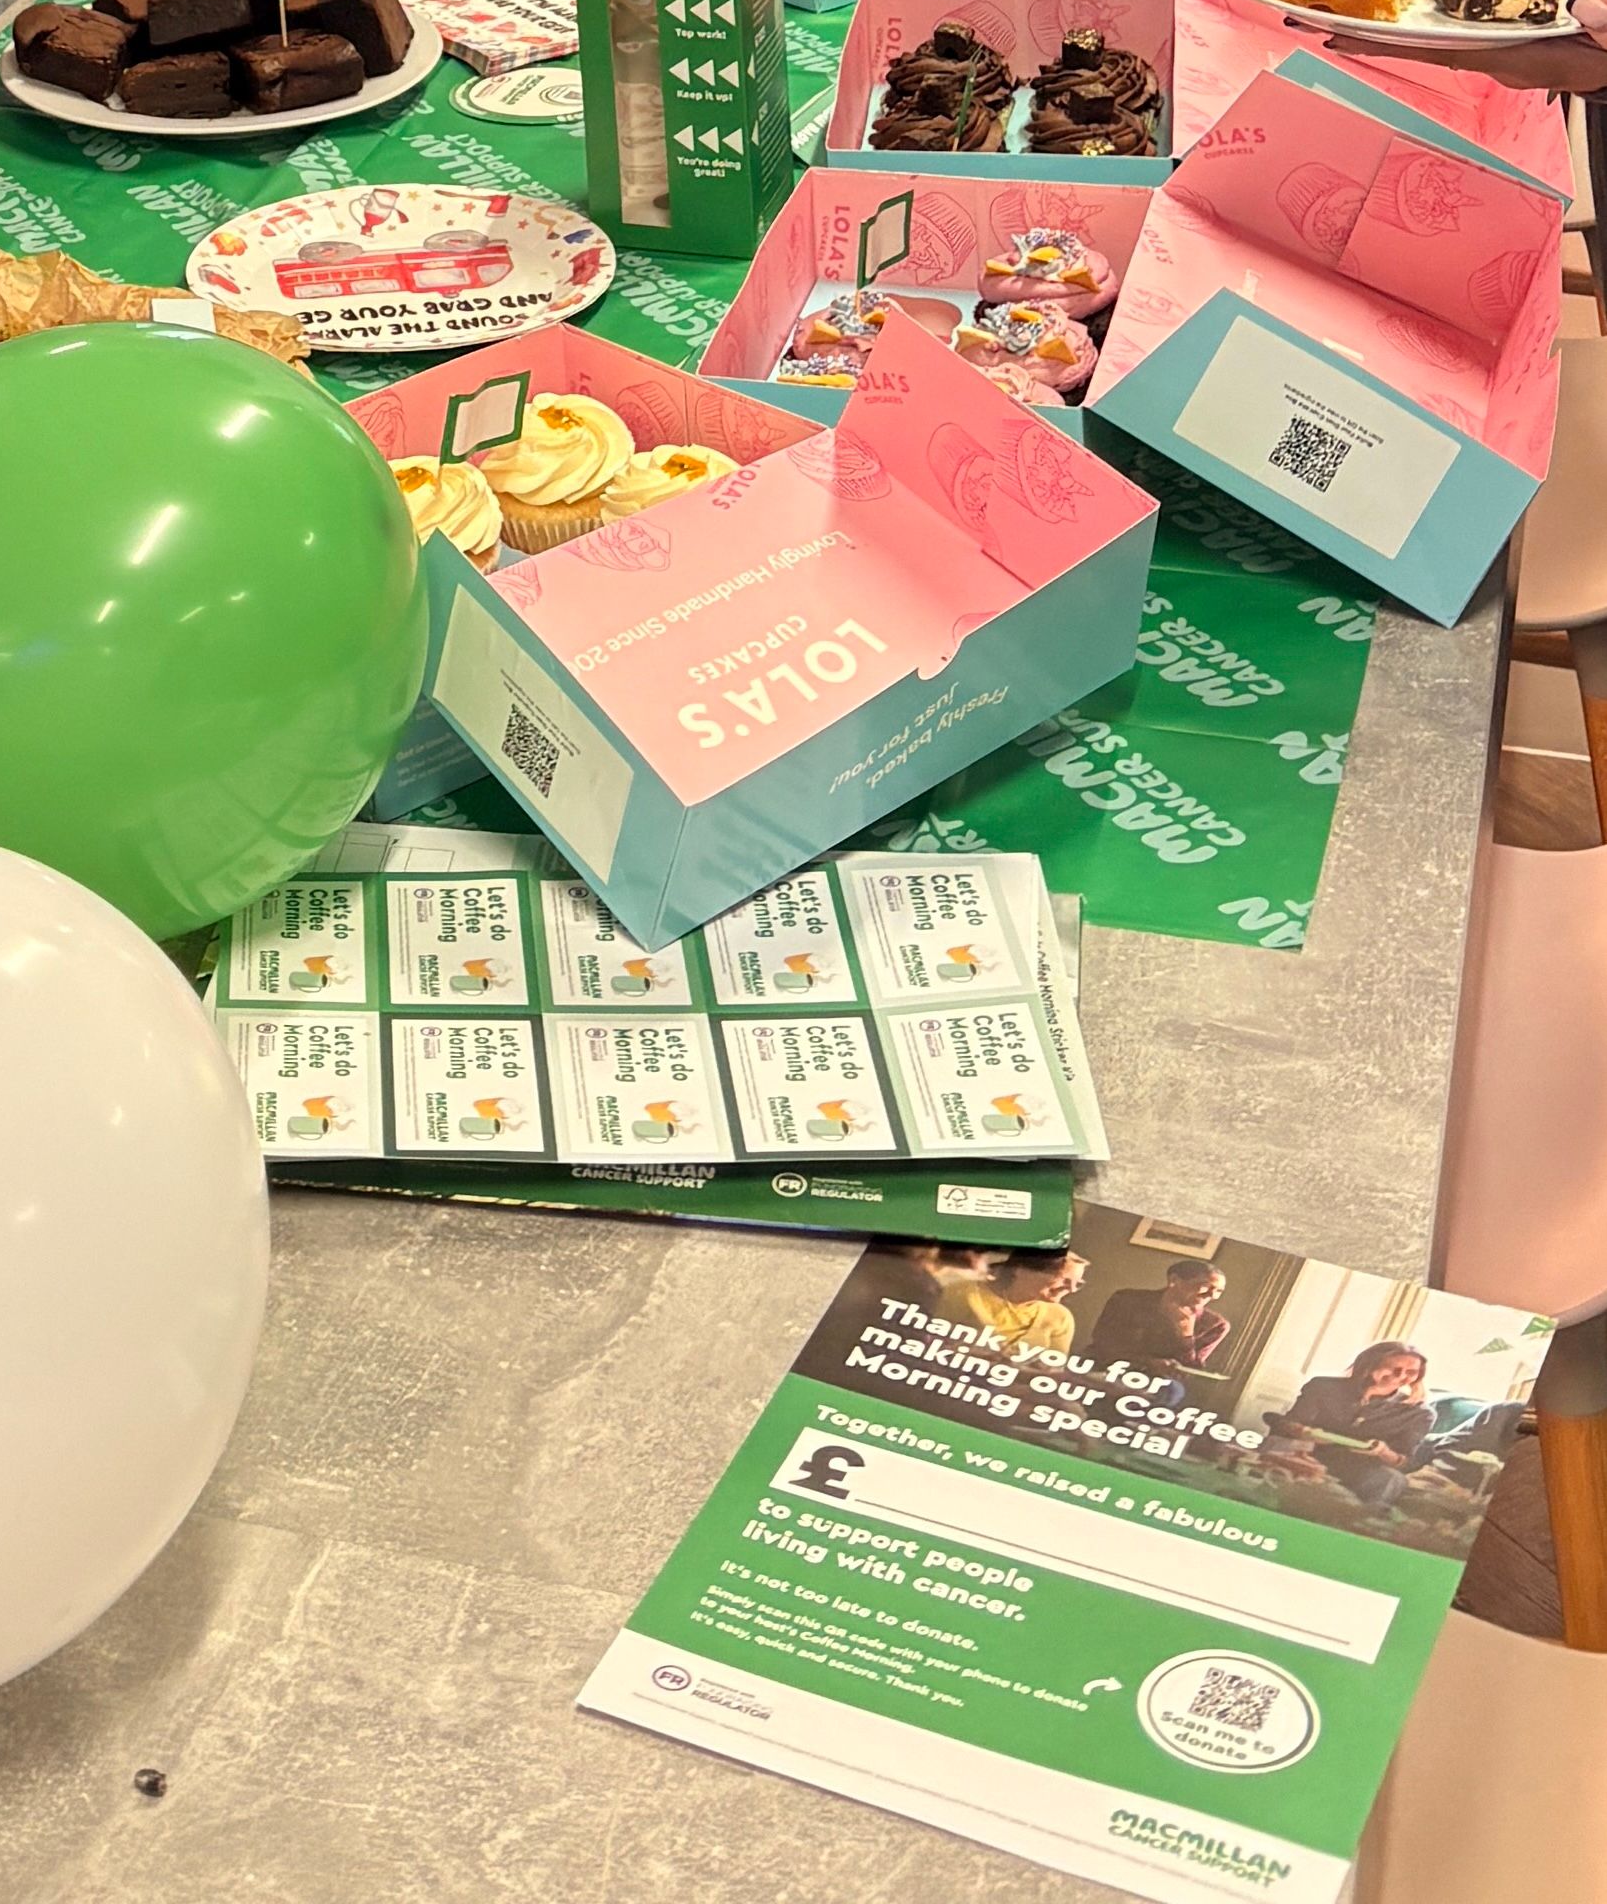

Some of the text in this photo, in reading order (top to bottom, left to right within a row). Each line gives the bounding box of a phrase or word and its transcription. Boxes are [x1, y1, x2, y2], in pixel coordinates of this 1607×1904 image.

[674, 28, 694, 39] Top
[676, 90, 703, 101] Keep
[711, 157, 742, 171] doing
[340, 292, 554, 322] AND GRAB YOUR
[390, 319, 441, 337] THE
[446, 311, 531, 331] SOUND
[606, 530, 854, 654] Lovingly Handmade Since
[687, 614, 809, 685] CUPCAKES
[1161, 615, 1285, 696] CANCER
[676, 617, 890, 749] LOLA'S
[914, 680, 961, 729] just
[935, 686, 1010, 733] Freshly
[877, 725, 912, 759] for
[1114, 752, 1247, 847] CANCER
[281, 887, 301, 940] Morning
[309, 887, 332, 932] Coffee
[437, 888, 458, 943] Morning
[463, 887, 485, 934] Coffee
[905, 874, 938, 931] Morning
[930, 873, 958, 921] Coffee
[965, 912, 988, 927] do
[333, 923, 355, 941] do
[490, 923, 512, 942] do
[279, 1024, 305, 1078] Morning
[308, 1024, 332, 1070] Coffee
[446, 1027, 474, 1079] Morning
[473, 1027, 499, 1071] Coffee
[612, 1027, 642, 1083] Morning
[639, 1028, 665, 1074] Coffee
[778, 1025, 812, 1082] Morning
[806, 1025, 831, 1072] Coffee
[946, 1017, 983, 1078] Morning
[972, 1015, 1004, 1067] Coffee
[1011, 1053, 1036, 1074] do
[334, 1059, 358, 1078] do
[502, 1061, 525, 1079] do
[670, 1064, 694, 1082] do
[840, 1062, 864, 1081] do
[571, 1166, 707, 1190] CANCER SUPPORT
[811, 1188, 884, 1202] REGULATOR
[880, 1297, 1173, 1395] Thank you for
[845, 1346, 1191, 1461] Morning special
[859, 1325, 1265, 1450] making our Coffee
[788, 1444, 866, 1500] £
[816, 1403, 1280, 1553] Together, we raised a fabulous
[757, 1497, 1035, 1593] to support people
[742, 1519, 1027, 1622] living with cancer.
[699, 1596, 718, 1609] to
[717, 1603, 754, 1621] your
[799, 1629, 851, 1653] Coffee
[719, 1559, 980, 1652] It's not too late to donate.
[756, 1603, 793, 1620] scan
[793, 1610, 822, 1630] this
[889, 1644, 925, 1662] with
[925, 1656, 962, 1676] your
[960, 1667, 1012, 1689] phone
[1012, 1680, 1033, 1695] to
[1032, 1688, 1089, 1713] donate
[796, 1647, 828, 1665] and
[885, 1673, 932, 1697] Thank
[1174, 1731, 1248, 1761] donate
[1214, 1730, 1248, 1746] me
[1253, 1741, 1276, 1755] to
[1108, 1824, 1276, 1888] CANCER SUPPORT
[1110, 1808, 1292, 1880] MACMILLAN
